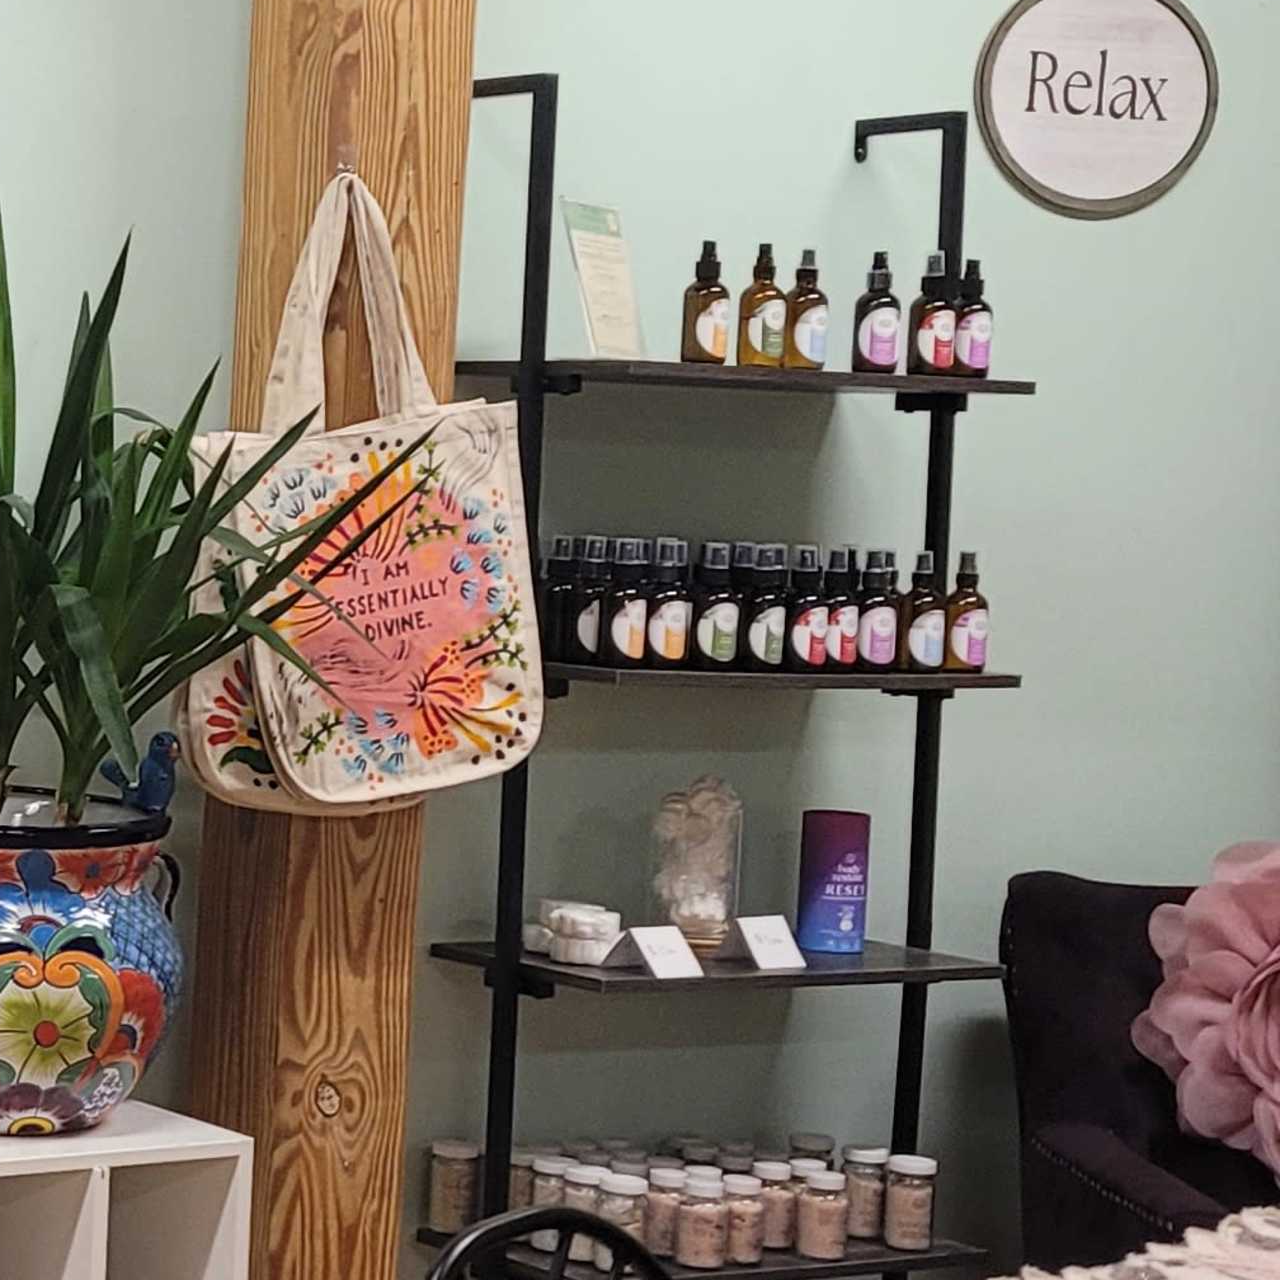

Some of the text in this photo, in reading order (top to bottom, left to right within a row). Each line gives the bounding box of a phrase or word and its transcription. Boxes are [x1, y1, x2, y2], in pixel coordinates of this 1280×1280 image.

[1023, 48, 1169, 122] Relax
[361, 560, 410, 586] I AM
[334, 576, 449, 621] ESSENTIALLY
[364, 610, 433, 642] DIVINE.
